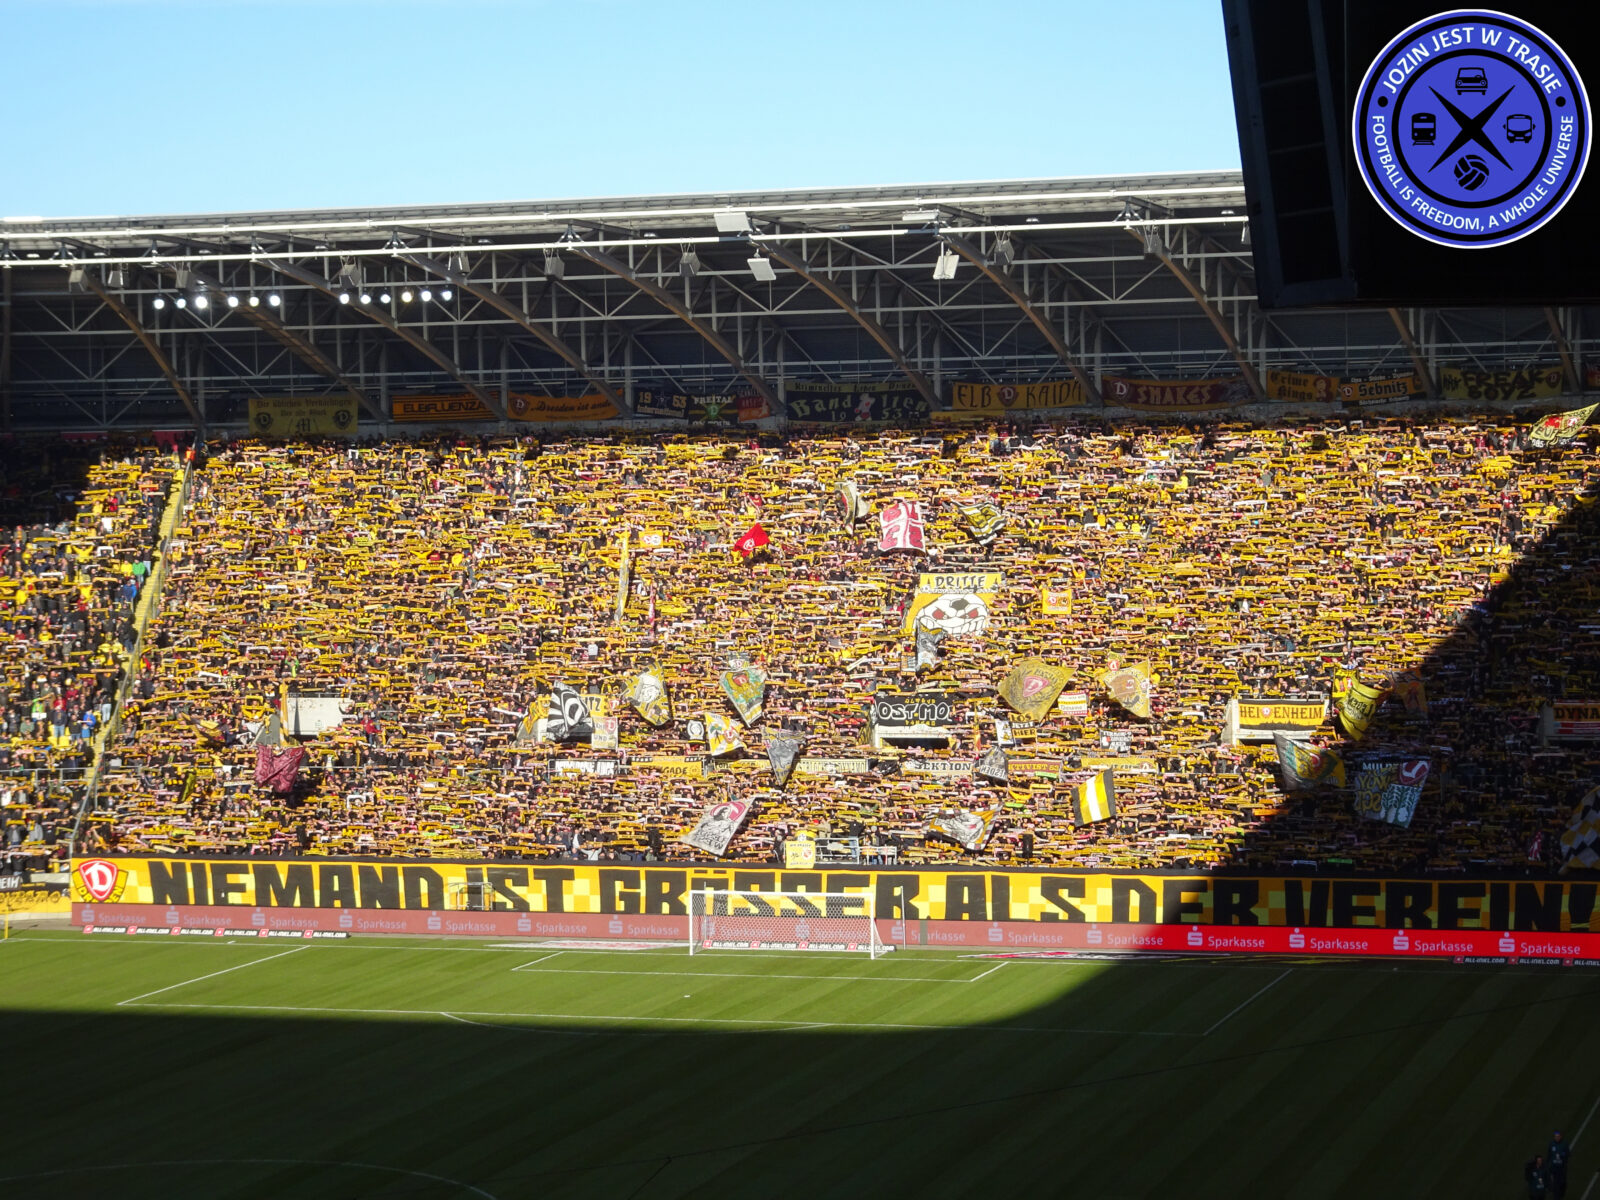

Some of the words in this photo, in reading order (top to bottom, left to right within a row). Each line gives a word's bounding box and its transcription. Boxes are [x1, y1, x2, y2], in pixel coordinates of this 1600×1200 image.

[958, 384, 992, 408] ELB
[935, 575, 986, 587] DRITTE
[148, 860, 445, 910] NIEMAND
[465, 866, 576, 913] IST
[598, 868, 920, 920] GRÖSSER
[946, 874, 1087, 923] ALS
[1111, 878, 1259, 926] DER
[99, 912, 146, 924] Sparkasse
[184, 914, 231, 926] Sparkasse
[270, 916, 319, 928] Sparkasse
[357, 918, 407, 931] Sparkasse
[445, 920, 496, 933] Sparkasse
[536, 922, 587, 935] Sparkasse
[628, 924, 680, 937] Sparkasse
[1008, 931, 1063, 945] Sparkasse
[1107, 932, 1163, 947] Sparkasse
[1208, 936, 1265, 949] Sparkasse
[1310, 937, 1368, 951] Sparkasse
[1414, 939, 1474, 953] Sparkasse
[1521, 942, 1581, 956] Sparkasse
